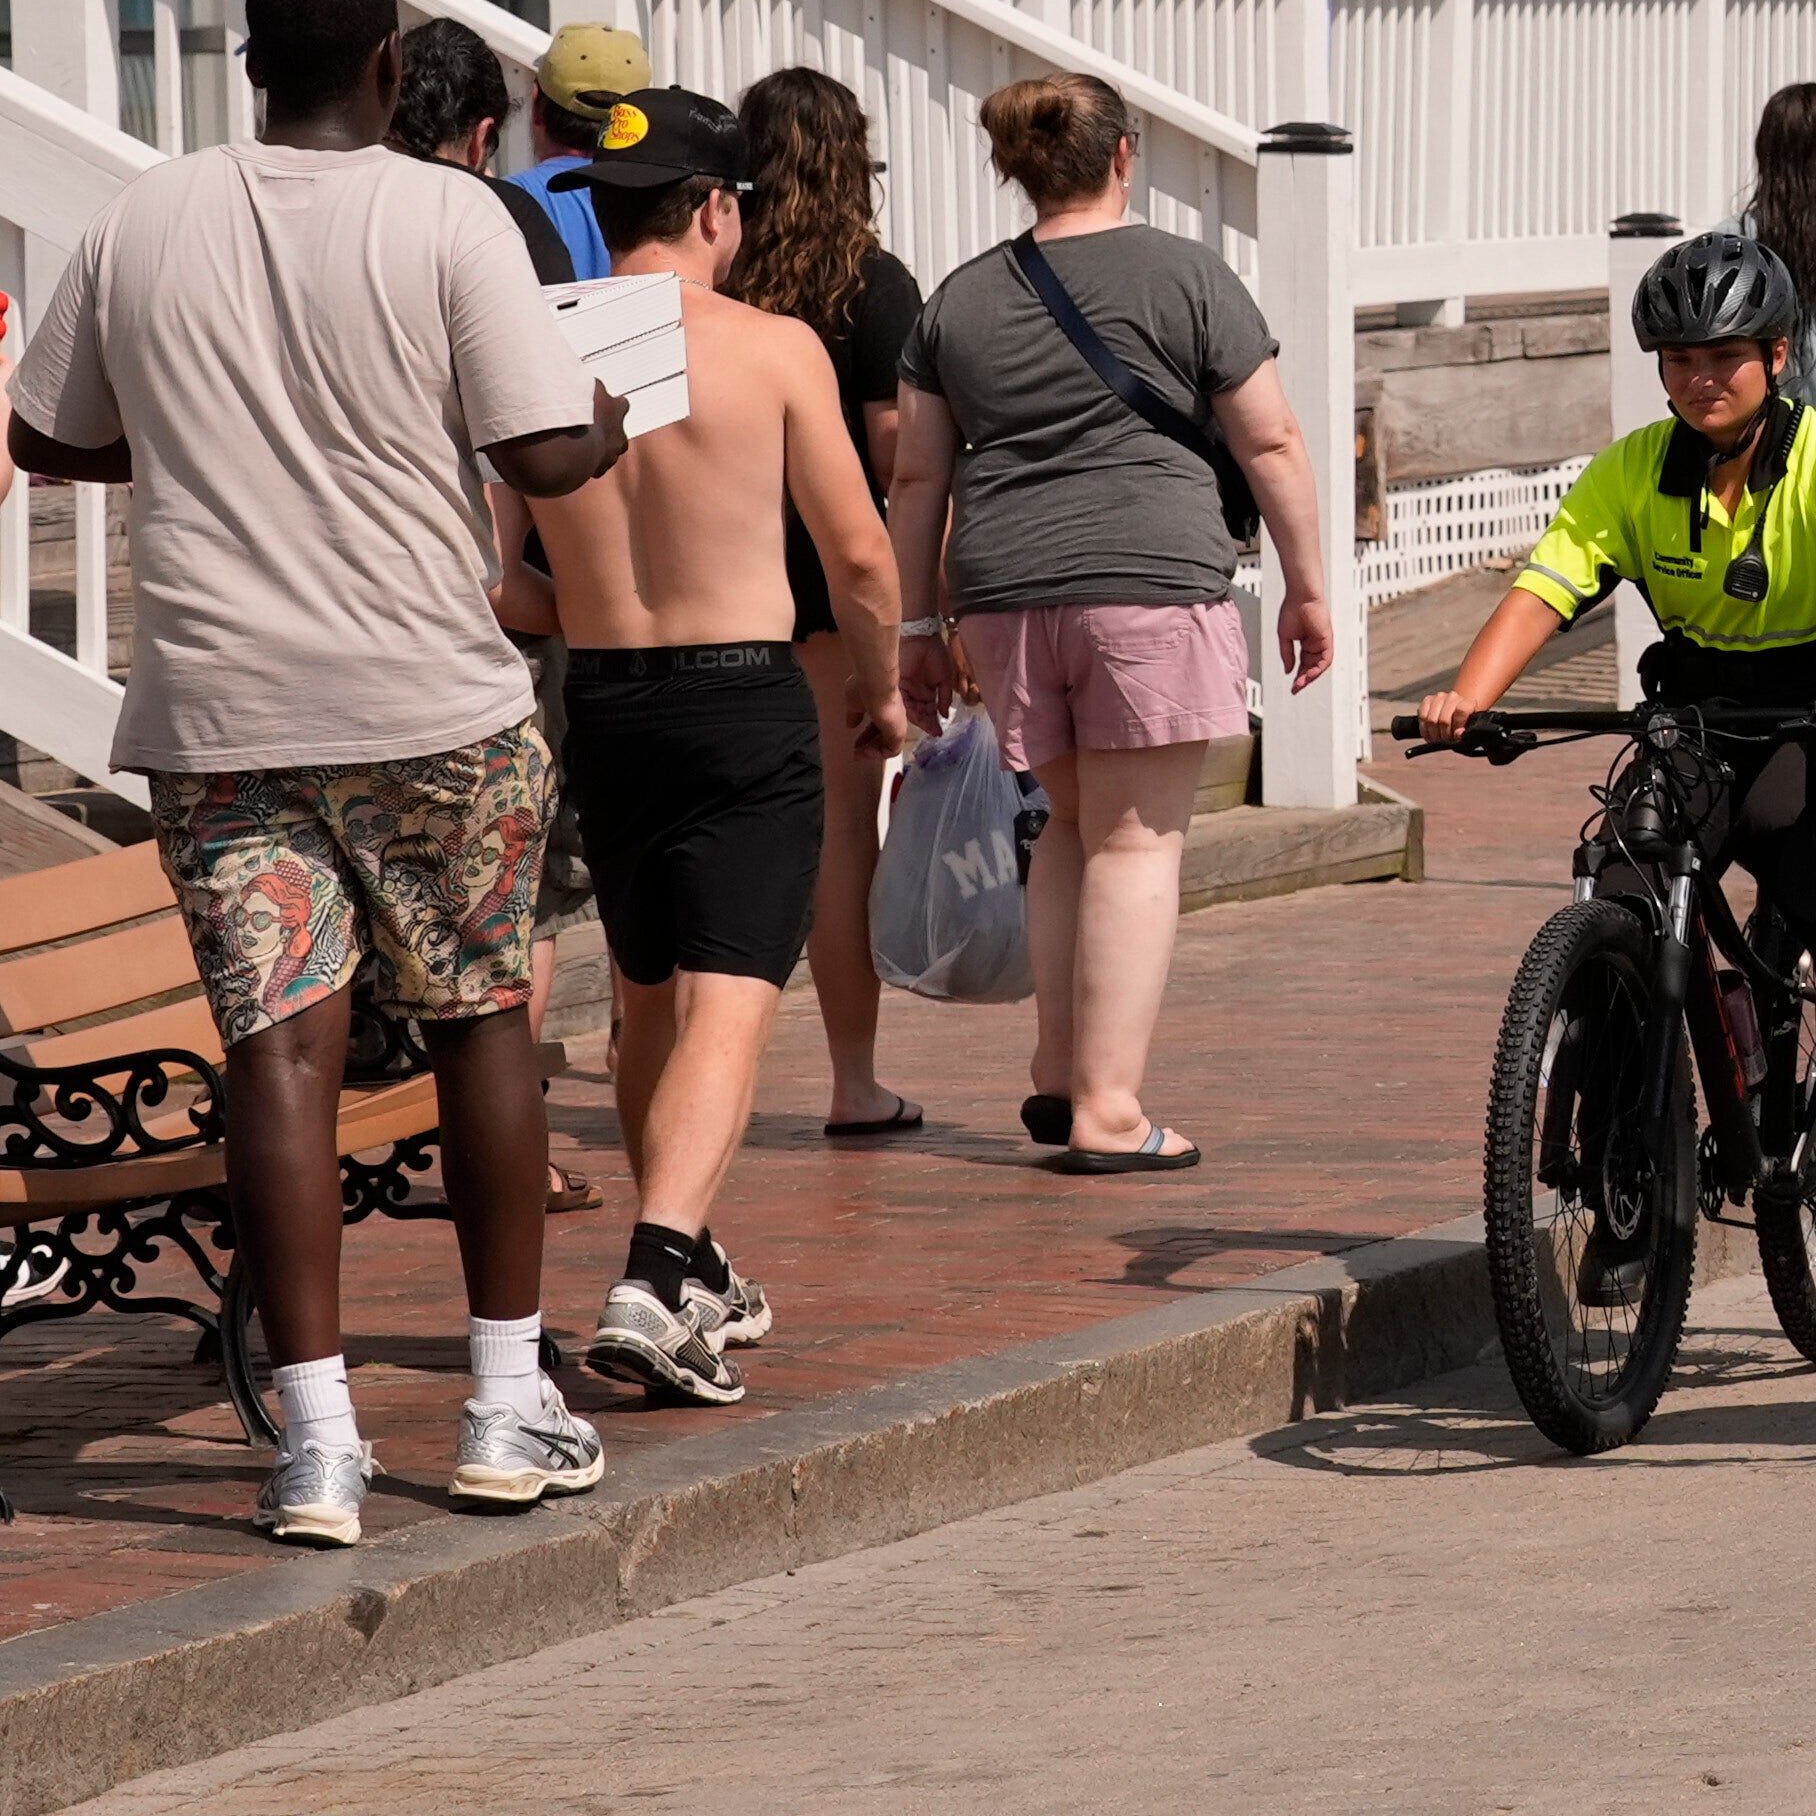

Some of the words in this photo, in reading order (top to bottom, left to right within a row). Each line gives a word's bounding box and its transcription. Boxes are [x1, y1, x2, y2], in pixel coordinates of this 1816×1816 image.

[613, 105, 638, 118] Bass
[611, 119, 629, 130] Pro
[673, 646, 771, 672] LCOM
